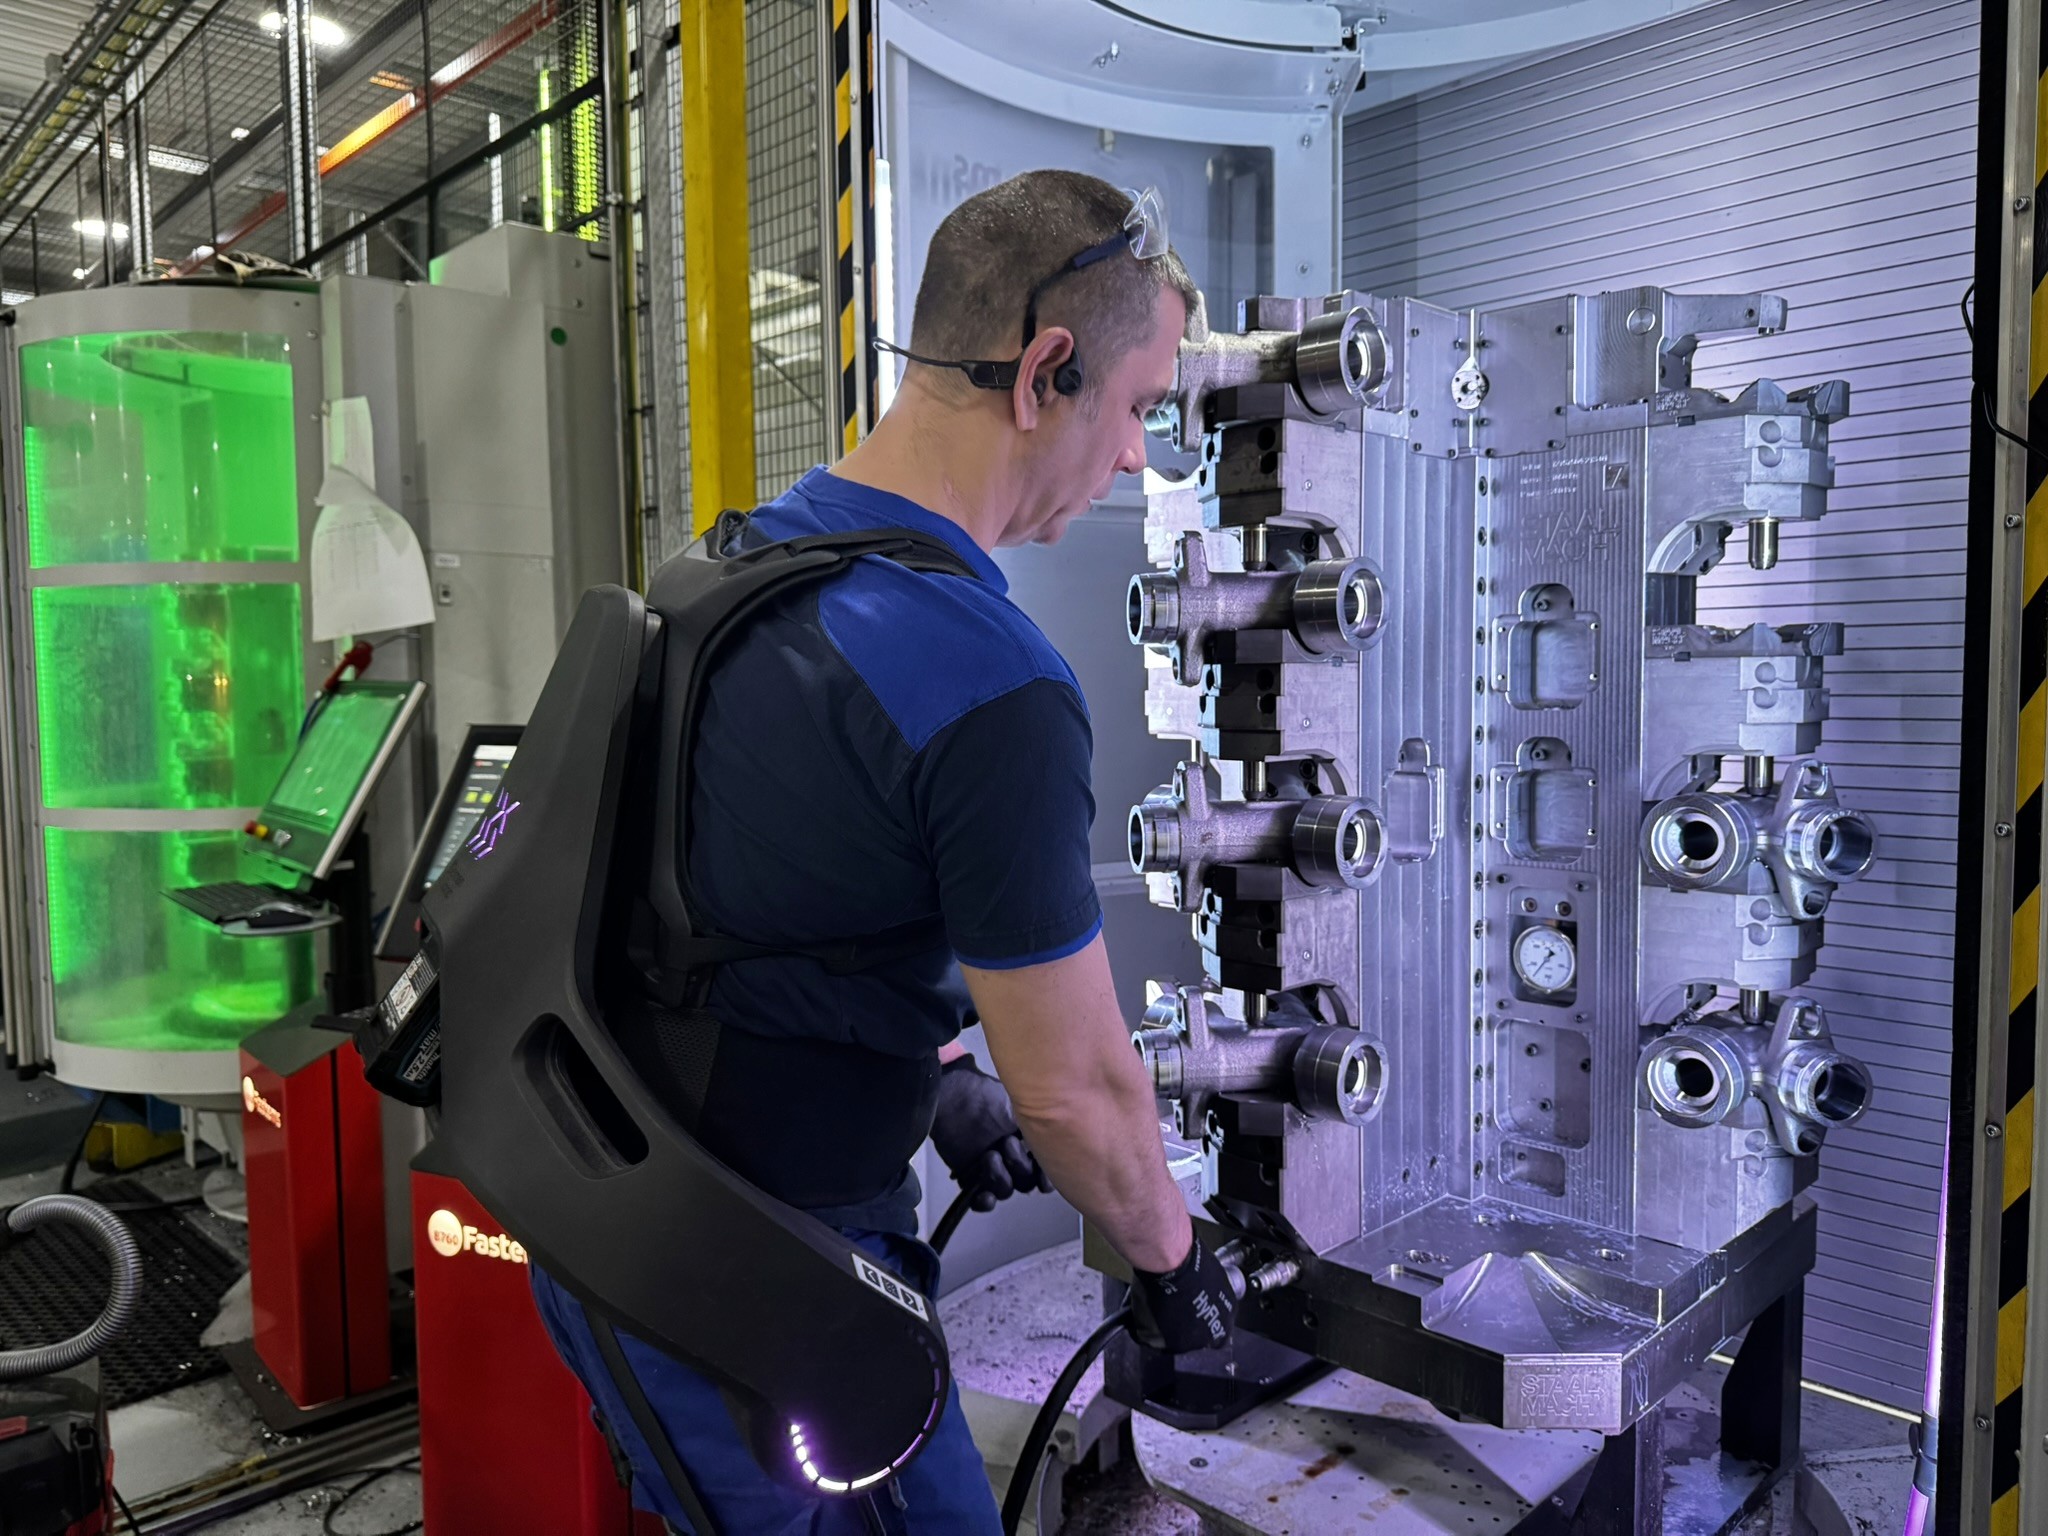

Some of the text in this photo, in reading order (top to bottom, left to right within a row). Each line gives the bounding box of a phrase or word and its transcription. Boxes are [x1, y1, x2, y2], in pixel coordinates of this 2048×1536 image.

[1192, 1289, 1226, 1341] HyFlex
[1520, 1373, 1606, 1397] STAAL
[1520, 1393, 1596, 1417] MACH
